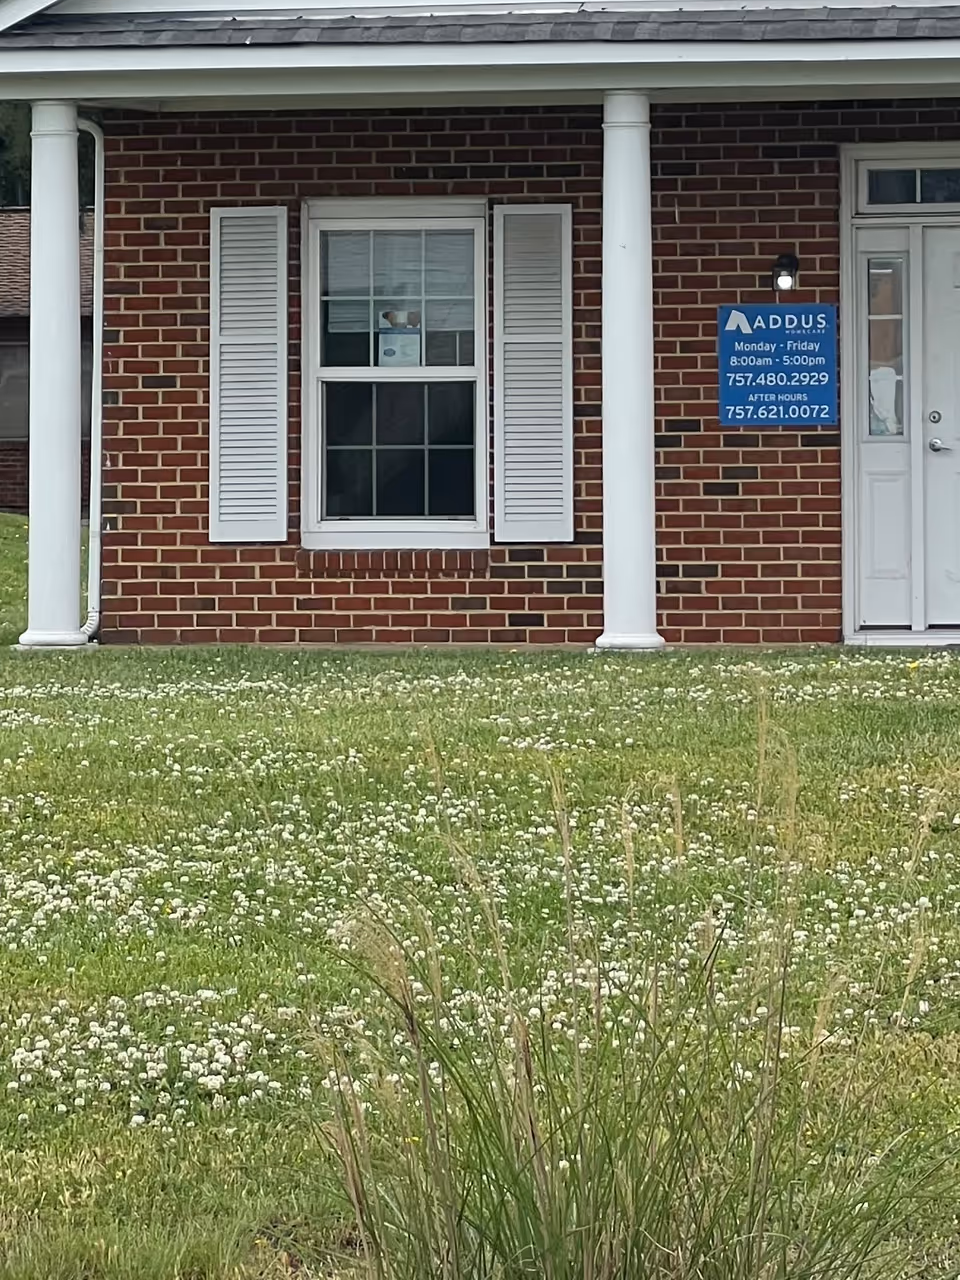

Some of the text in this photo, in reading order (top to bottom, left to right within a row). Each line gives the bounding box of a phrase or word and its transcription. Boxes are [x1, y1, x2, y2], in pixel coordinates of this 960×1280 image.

[753, 313, 827, 329] ADDUS
[734, 341, 777, 353] Monday
[786, 340, 820, 352] Friday
[730, 355, 773, 366] 8:00am
[782, 355, 826, 366] 5:00pm
[726, 372, 829, 386] 757.480.2929
[748, 393, 808, 401] AFTER HOURS
[725, 405, 830, 419] 757.621.0072
